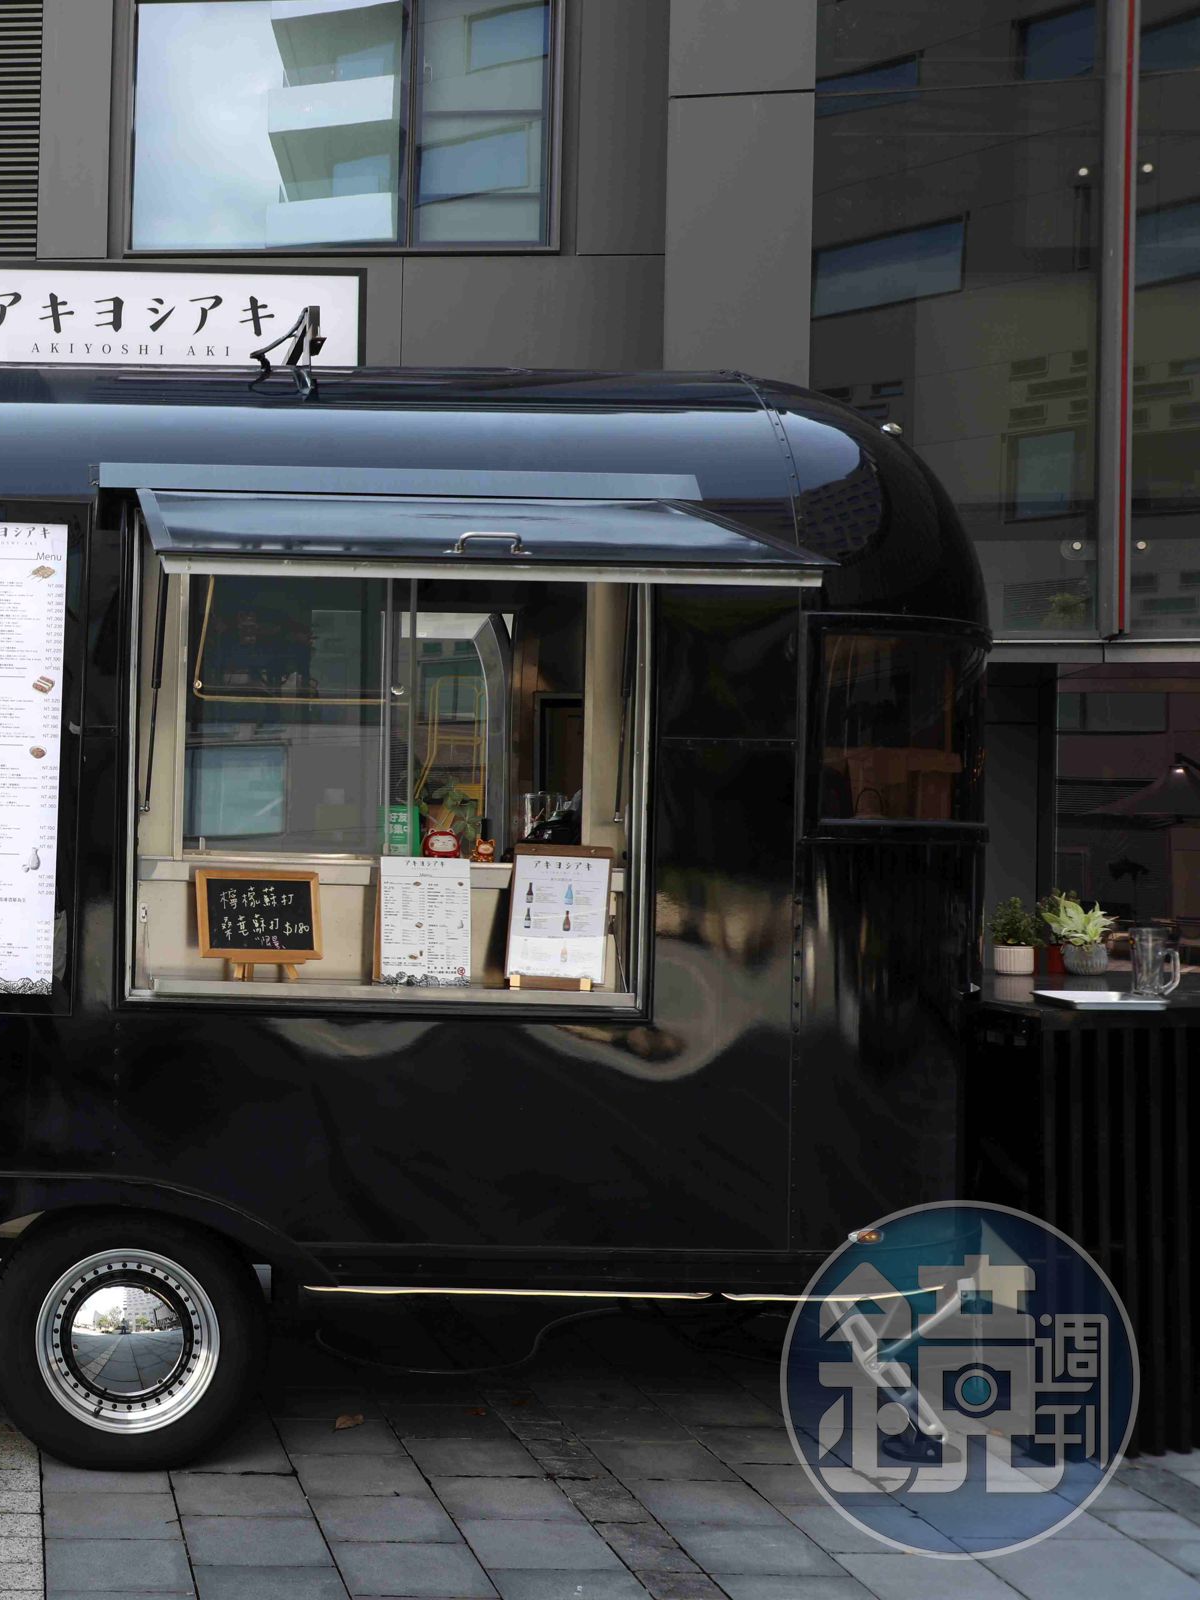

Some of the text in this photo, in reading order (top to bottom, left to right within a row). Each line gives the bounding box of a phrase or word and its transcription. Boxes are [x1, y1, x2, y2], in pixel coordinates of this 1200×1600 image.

[31, 342, 231, 357] AKIYOSHI AKI
[36, 552, 62, 562] Menu
[533, 860, 593, 871] アキヨシアキ
[283, 921, 310, 936] $180
